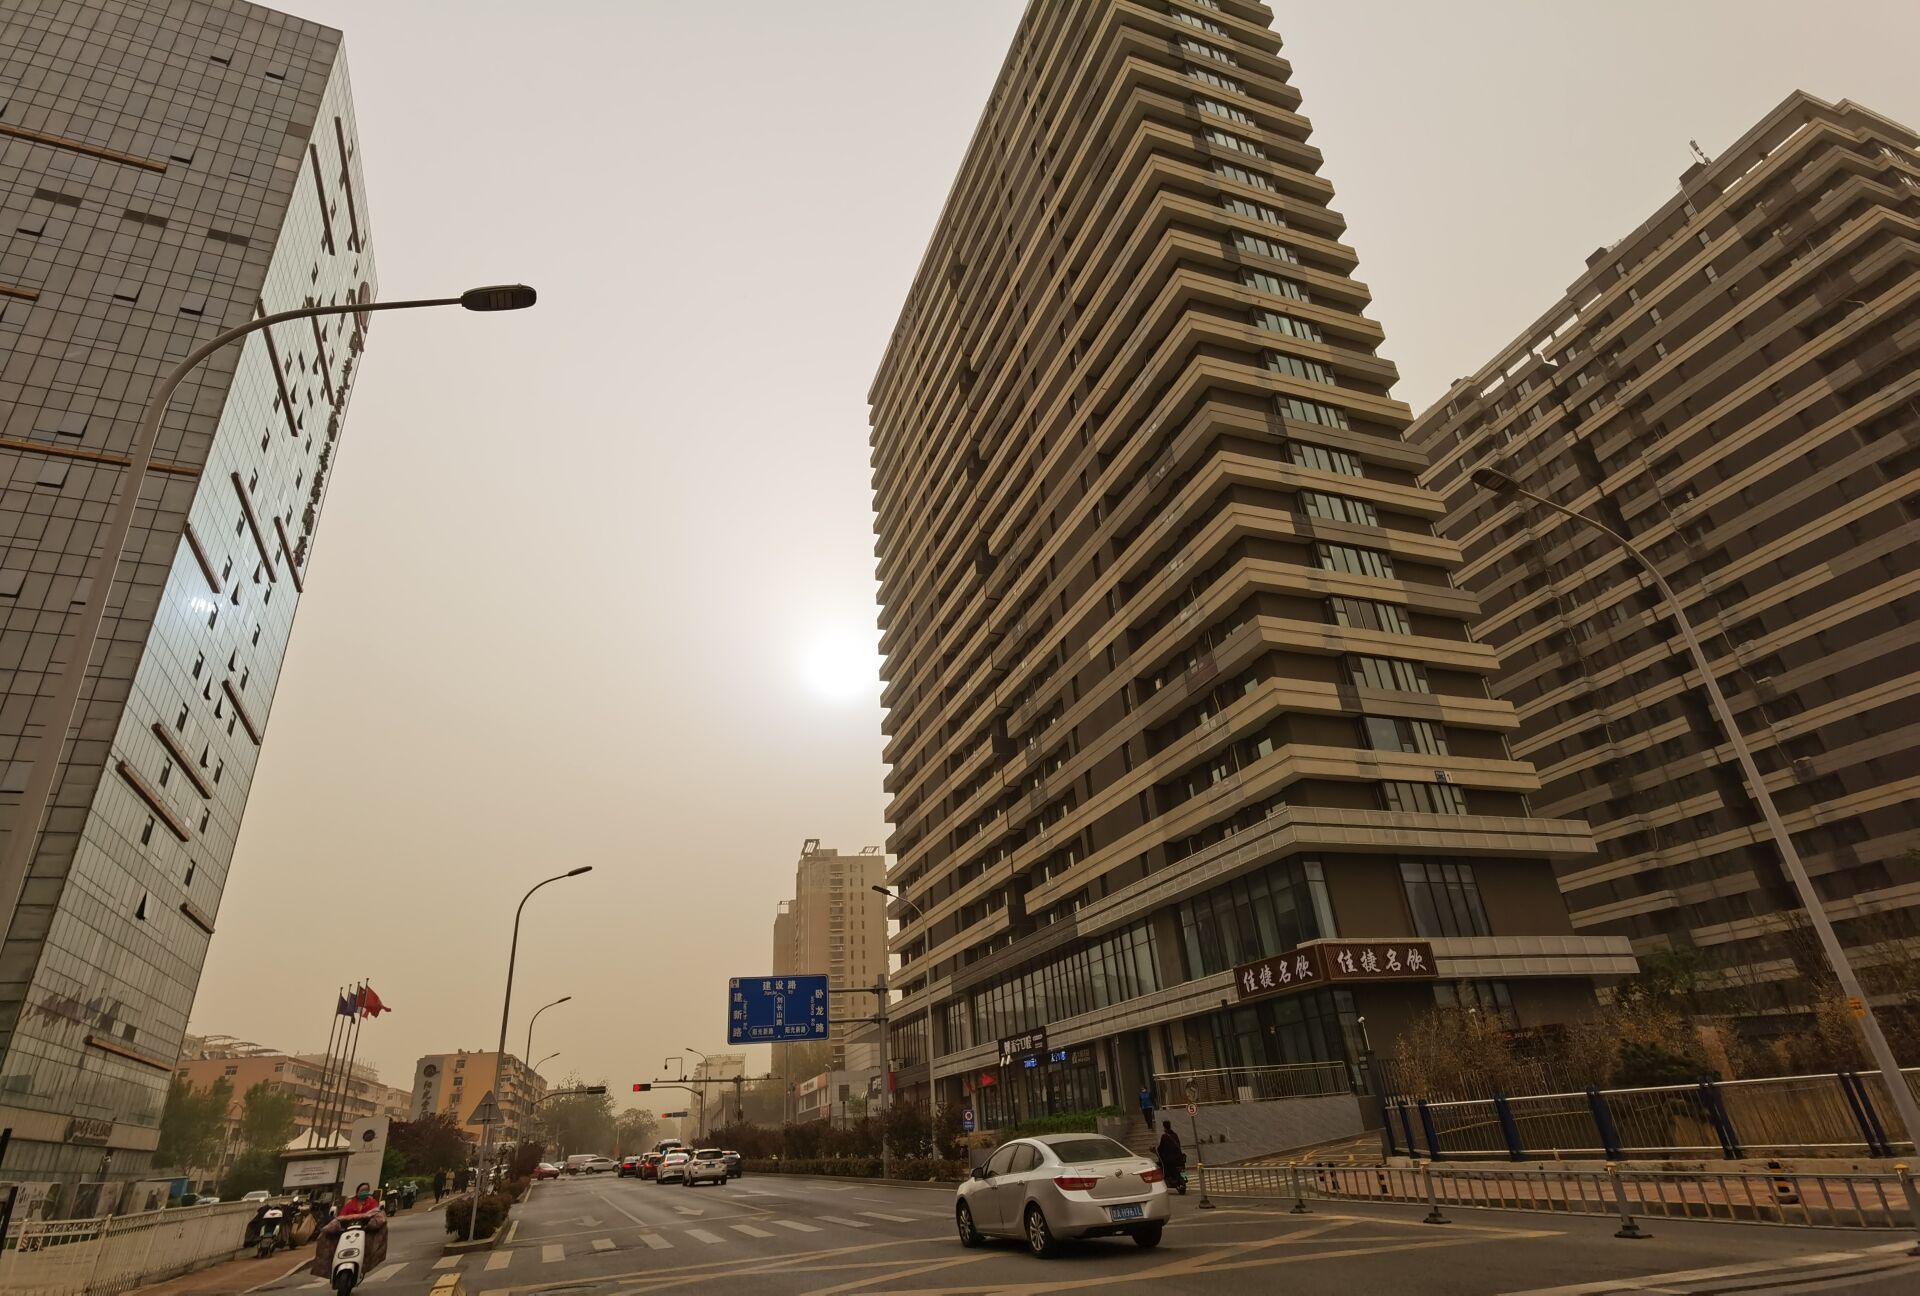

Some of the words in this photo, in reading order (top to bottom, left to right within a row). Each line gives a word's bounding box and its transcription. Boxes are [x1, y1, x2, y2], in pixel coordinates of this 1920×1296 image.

[763, 980, 796, 990] 建设路
[733, 993, 742, 1037] 建新路
[816, 989, 824, 1032] 卧龙路
